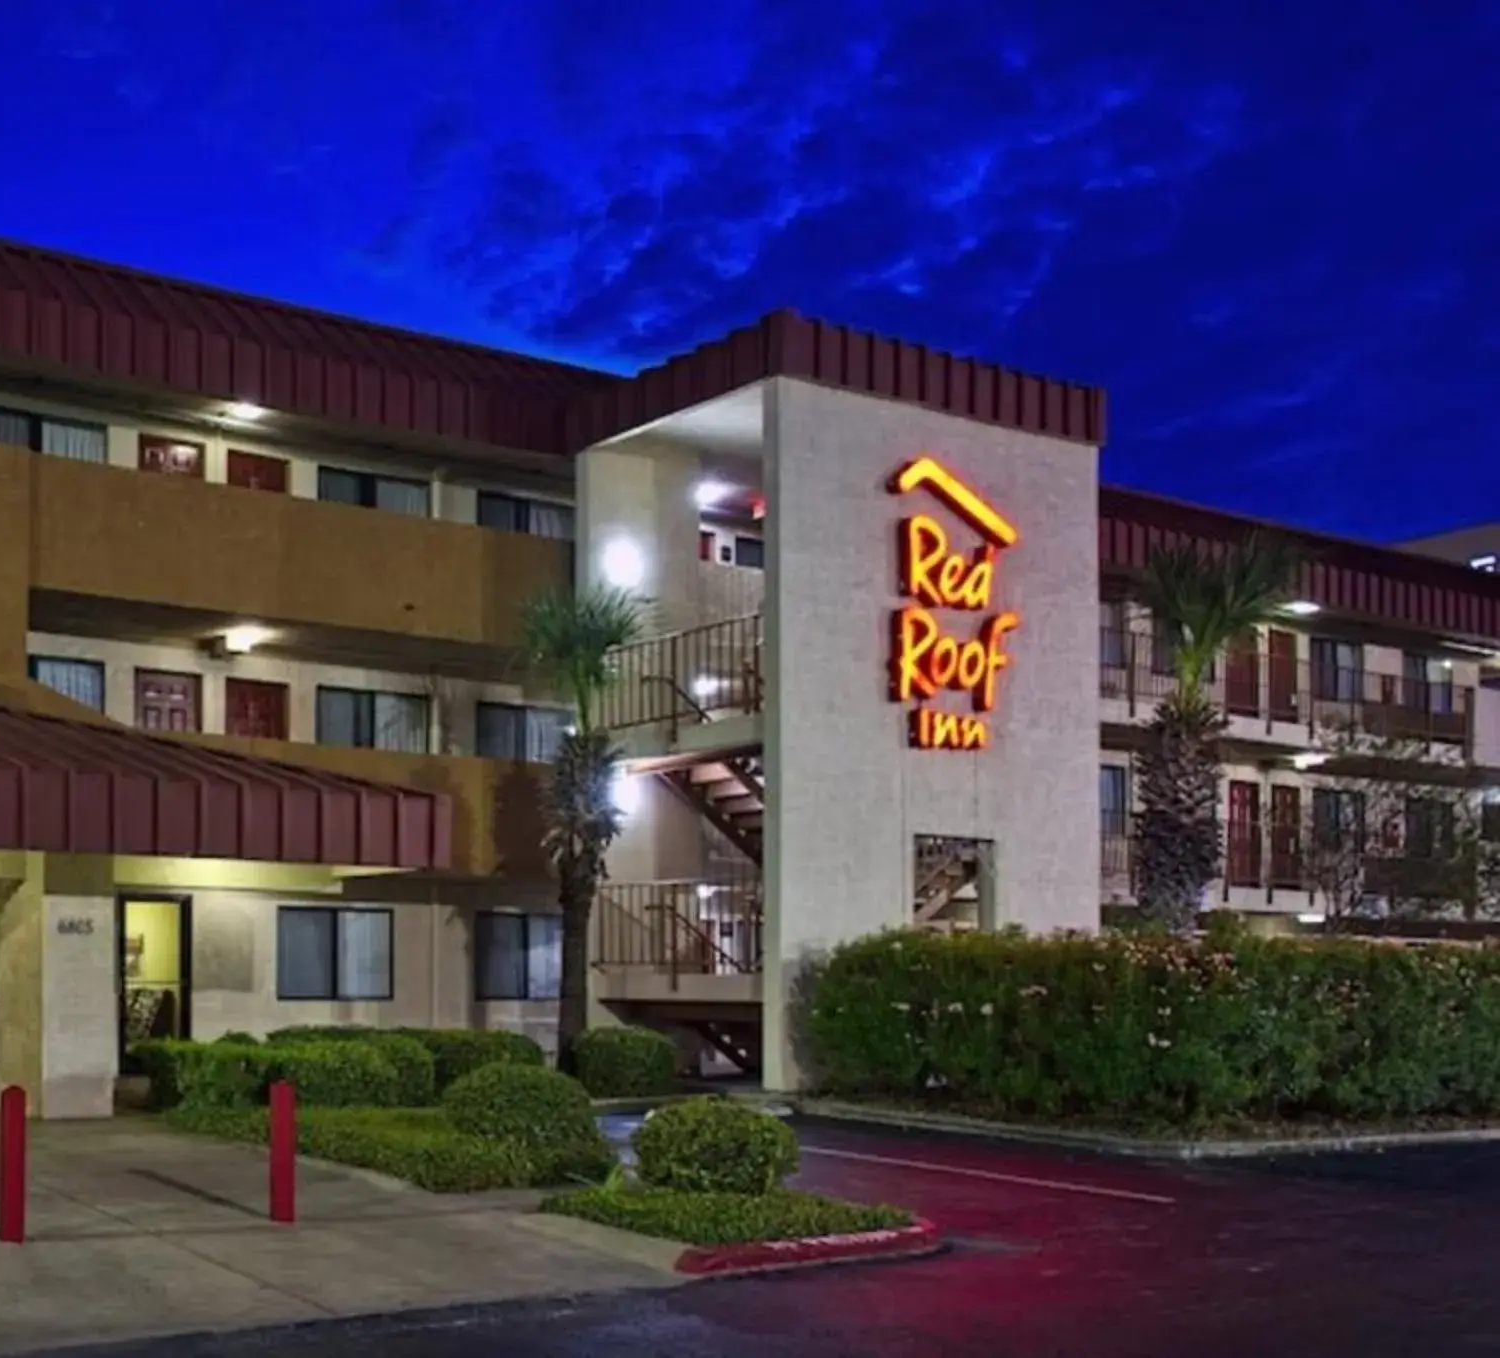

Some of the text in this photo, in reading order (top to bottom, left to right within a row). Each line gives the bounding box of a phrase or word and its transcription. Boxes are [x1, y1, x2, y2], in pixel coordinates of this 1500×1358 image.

[902, 514, 997, 609] Red
[894, 606, 1021, 710] Roof
[913, 708, 989, 748] Inn
